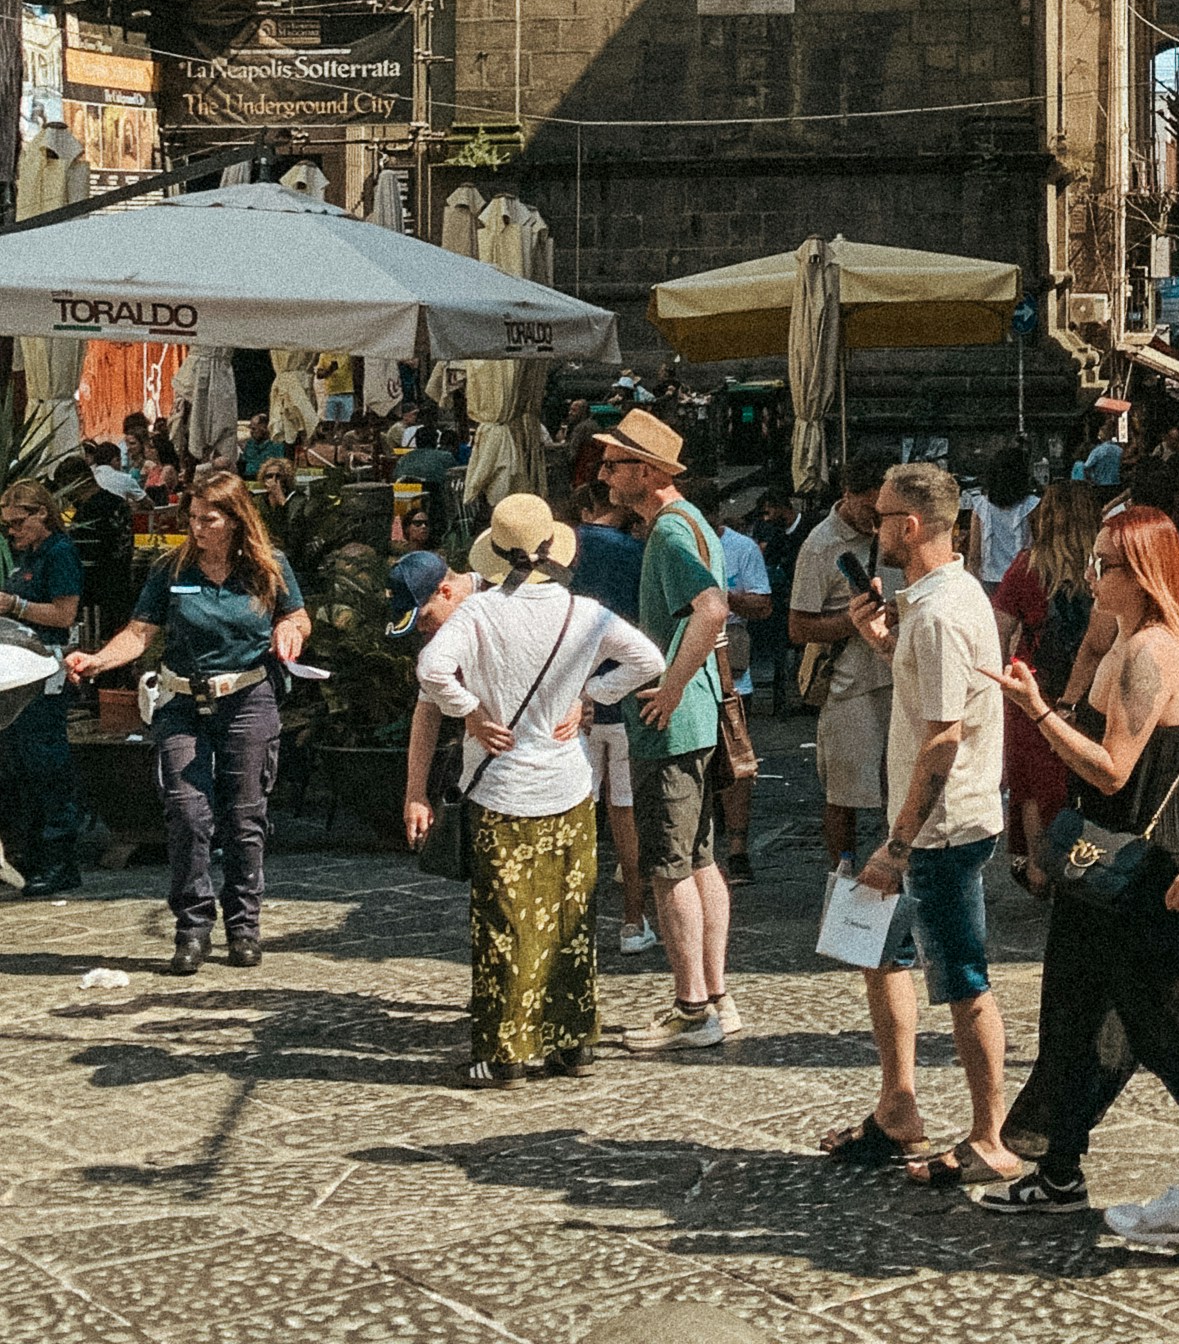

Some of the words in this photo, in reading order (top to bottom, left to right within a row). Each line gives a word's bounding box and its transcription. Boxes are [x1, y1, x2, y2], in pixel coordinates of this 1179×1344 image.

[209, 58, 292, 83] Neapolis
[295, 56, 401, 79] Sotterrata
[182, 93, 219, 115] The
[224, 92, 349, 119] Underground
[353, 91, 396, 119] City
[52, 298, 198, 328] TORALDO
[504, 320, 553, 345] TORALDO
